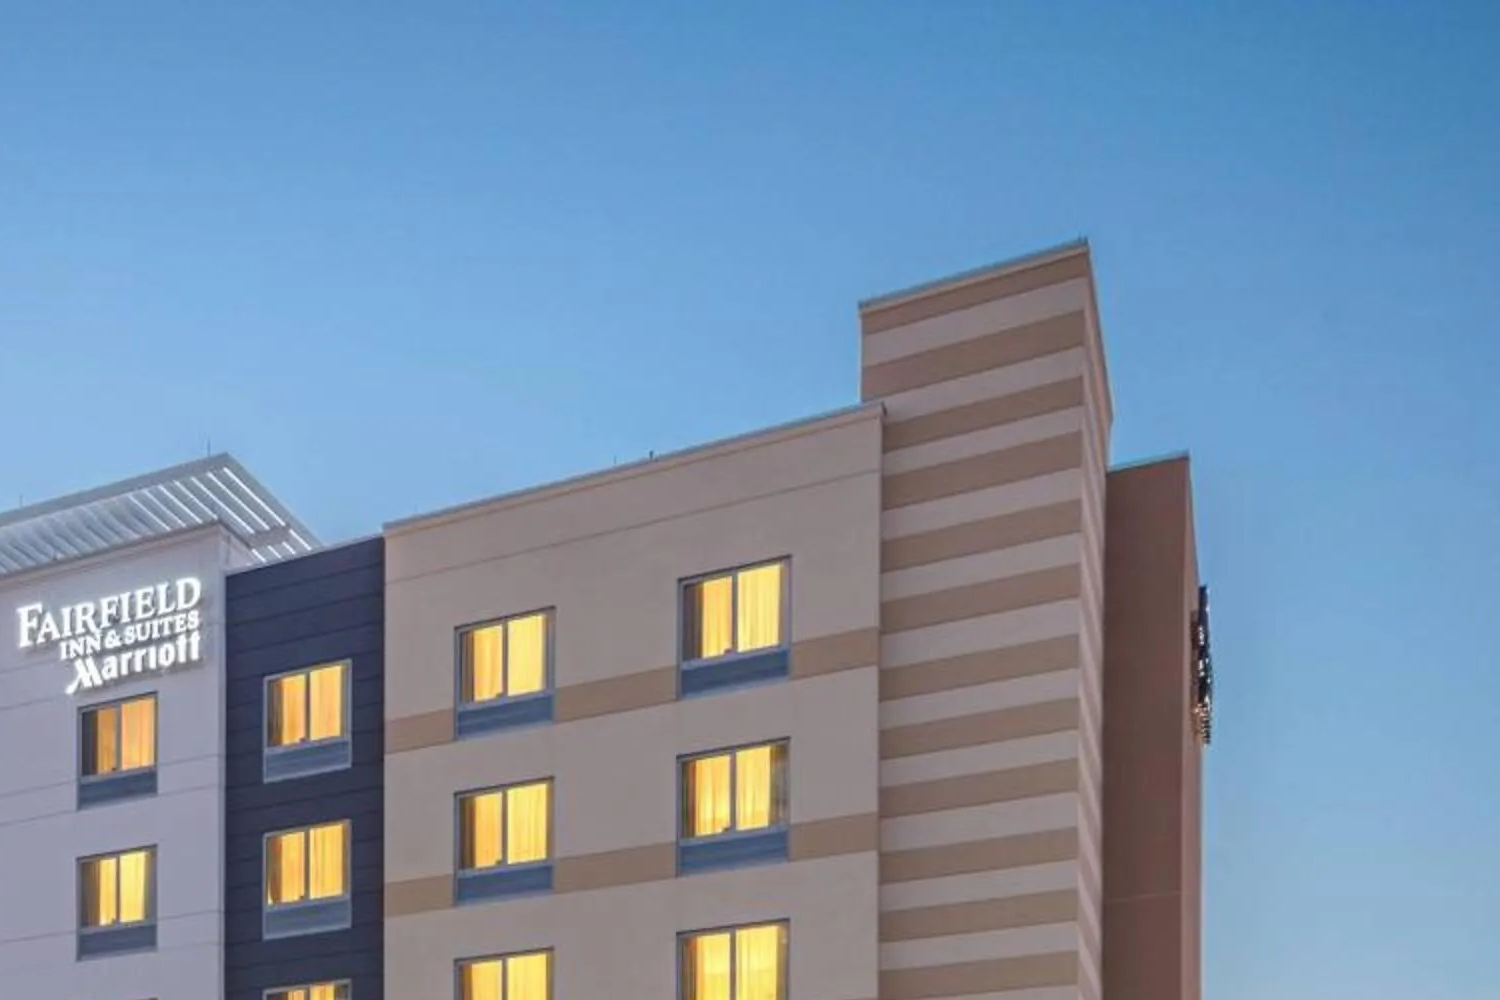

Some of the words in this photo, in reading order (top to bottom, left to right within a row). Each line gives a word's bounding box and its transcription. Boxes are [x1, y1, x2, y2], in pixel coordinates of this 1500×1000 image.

[16, 577, 201, 648] FAIRFIELD
[60, 634, 101, 661] INN
[104, 631, 122, 649] &
[123, 610, 199, 645] SUITES
[65, 630, 200, 695] Marriott
